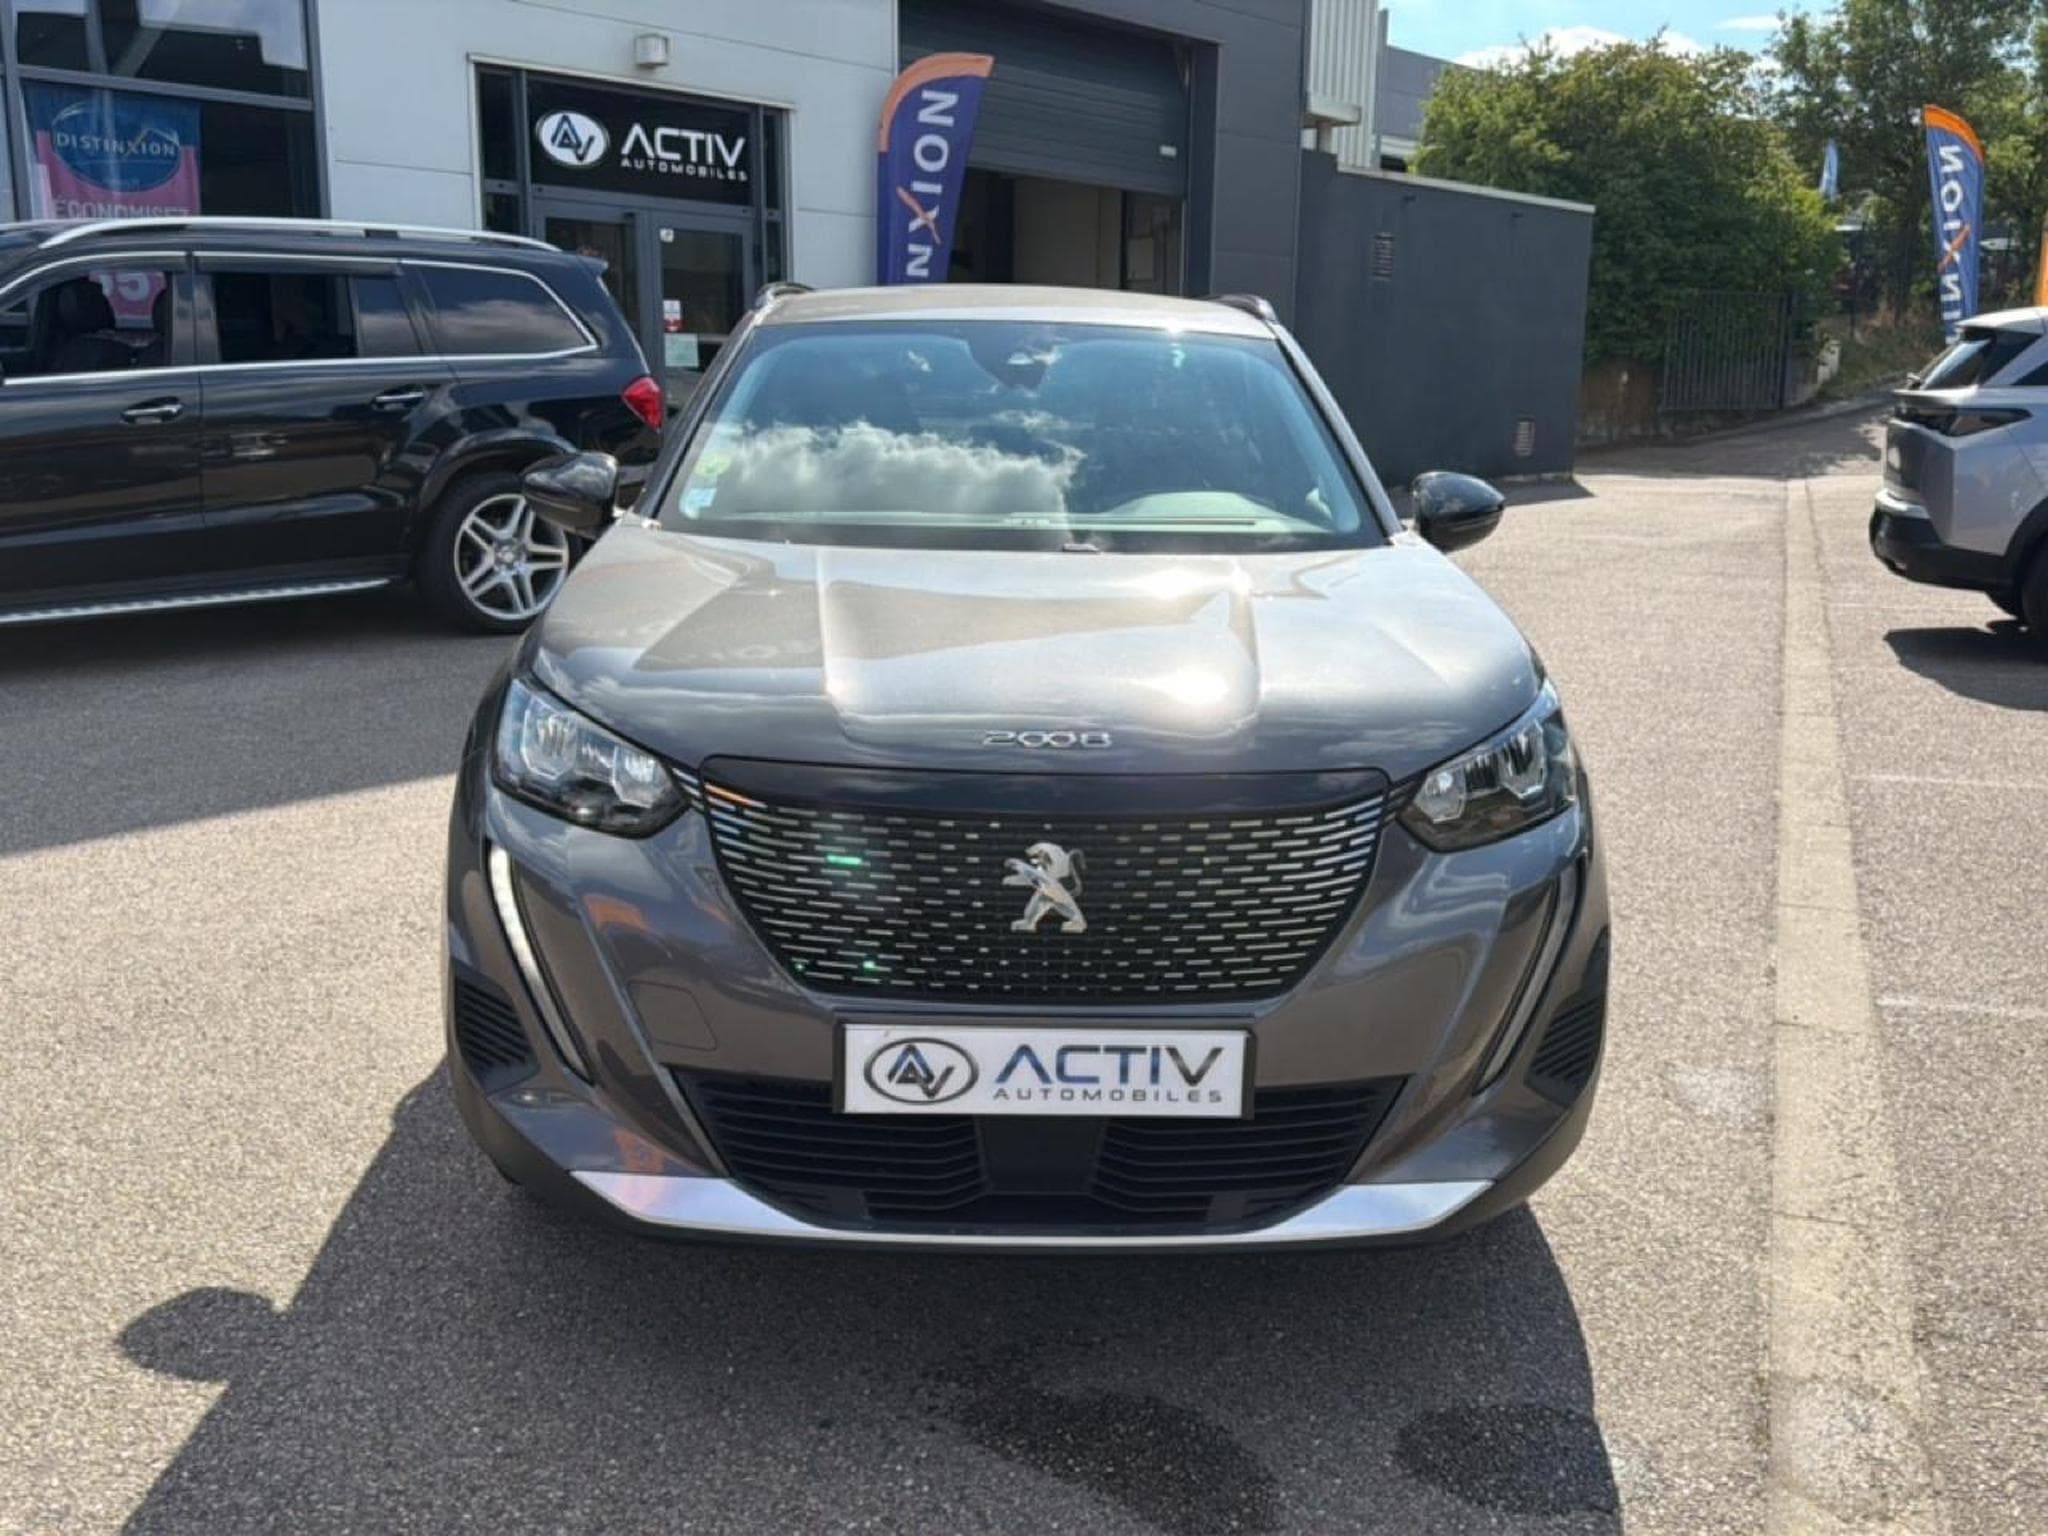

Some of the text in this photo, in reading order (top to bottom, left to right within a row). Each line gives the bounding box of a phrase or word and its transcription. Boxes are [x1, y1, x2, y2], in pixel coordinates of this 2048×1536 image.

[56, 131, 176, 157] DISTINXION
[620, 122, 745, 168] ACTIV
[620, 157, 748, 182] AUTOMOBILES
[983, 730, 1112, 748] 2008
[995, 1044, 1224, 1087] ACTIV
[993, 1087, 1223, 1103] AUTOMOBILES
